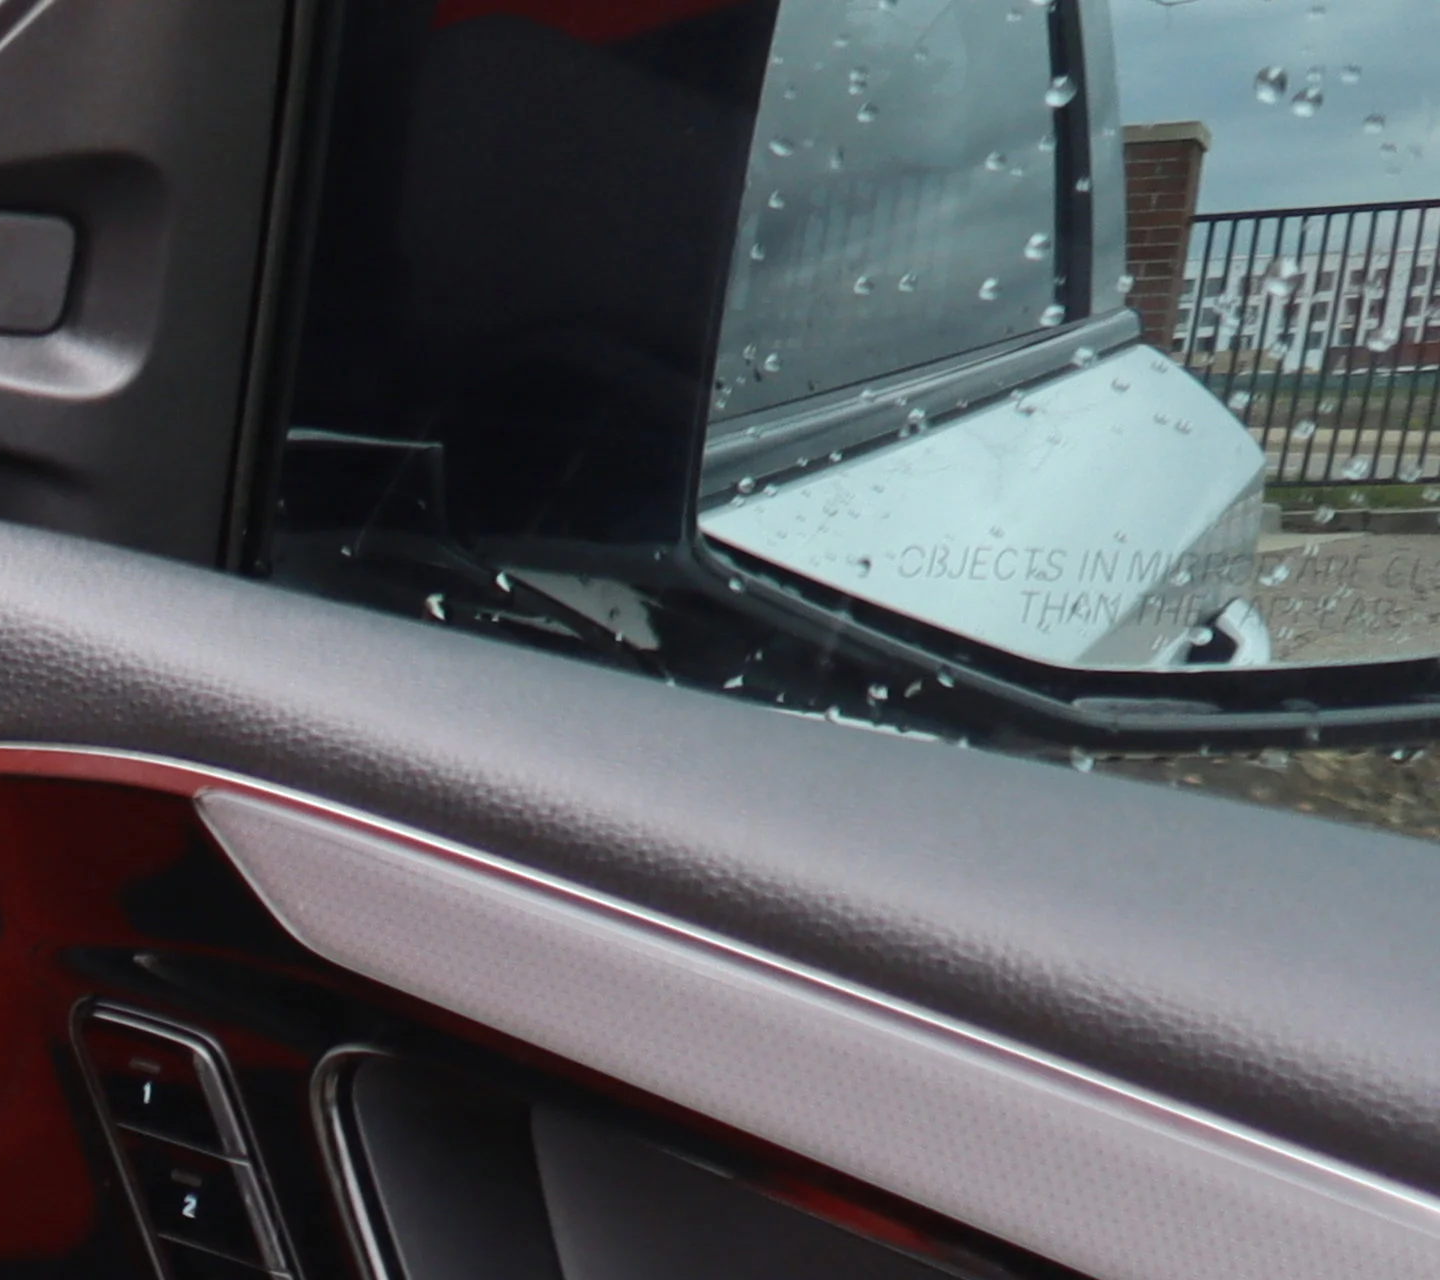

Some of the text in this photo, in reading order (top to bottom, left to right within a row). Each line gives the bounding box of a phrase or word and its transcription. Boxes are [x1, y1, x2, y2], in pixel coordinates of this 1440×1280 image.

[898, 545, 1067, 581] OBJECTS
[1078, 550, 1120, 582] IN
[1019, 590, 1120, 625] THAN
[142, 1081, 153, 1105] 1
[182, 1194, 197, 1218] 2
